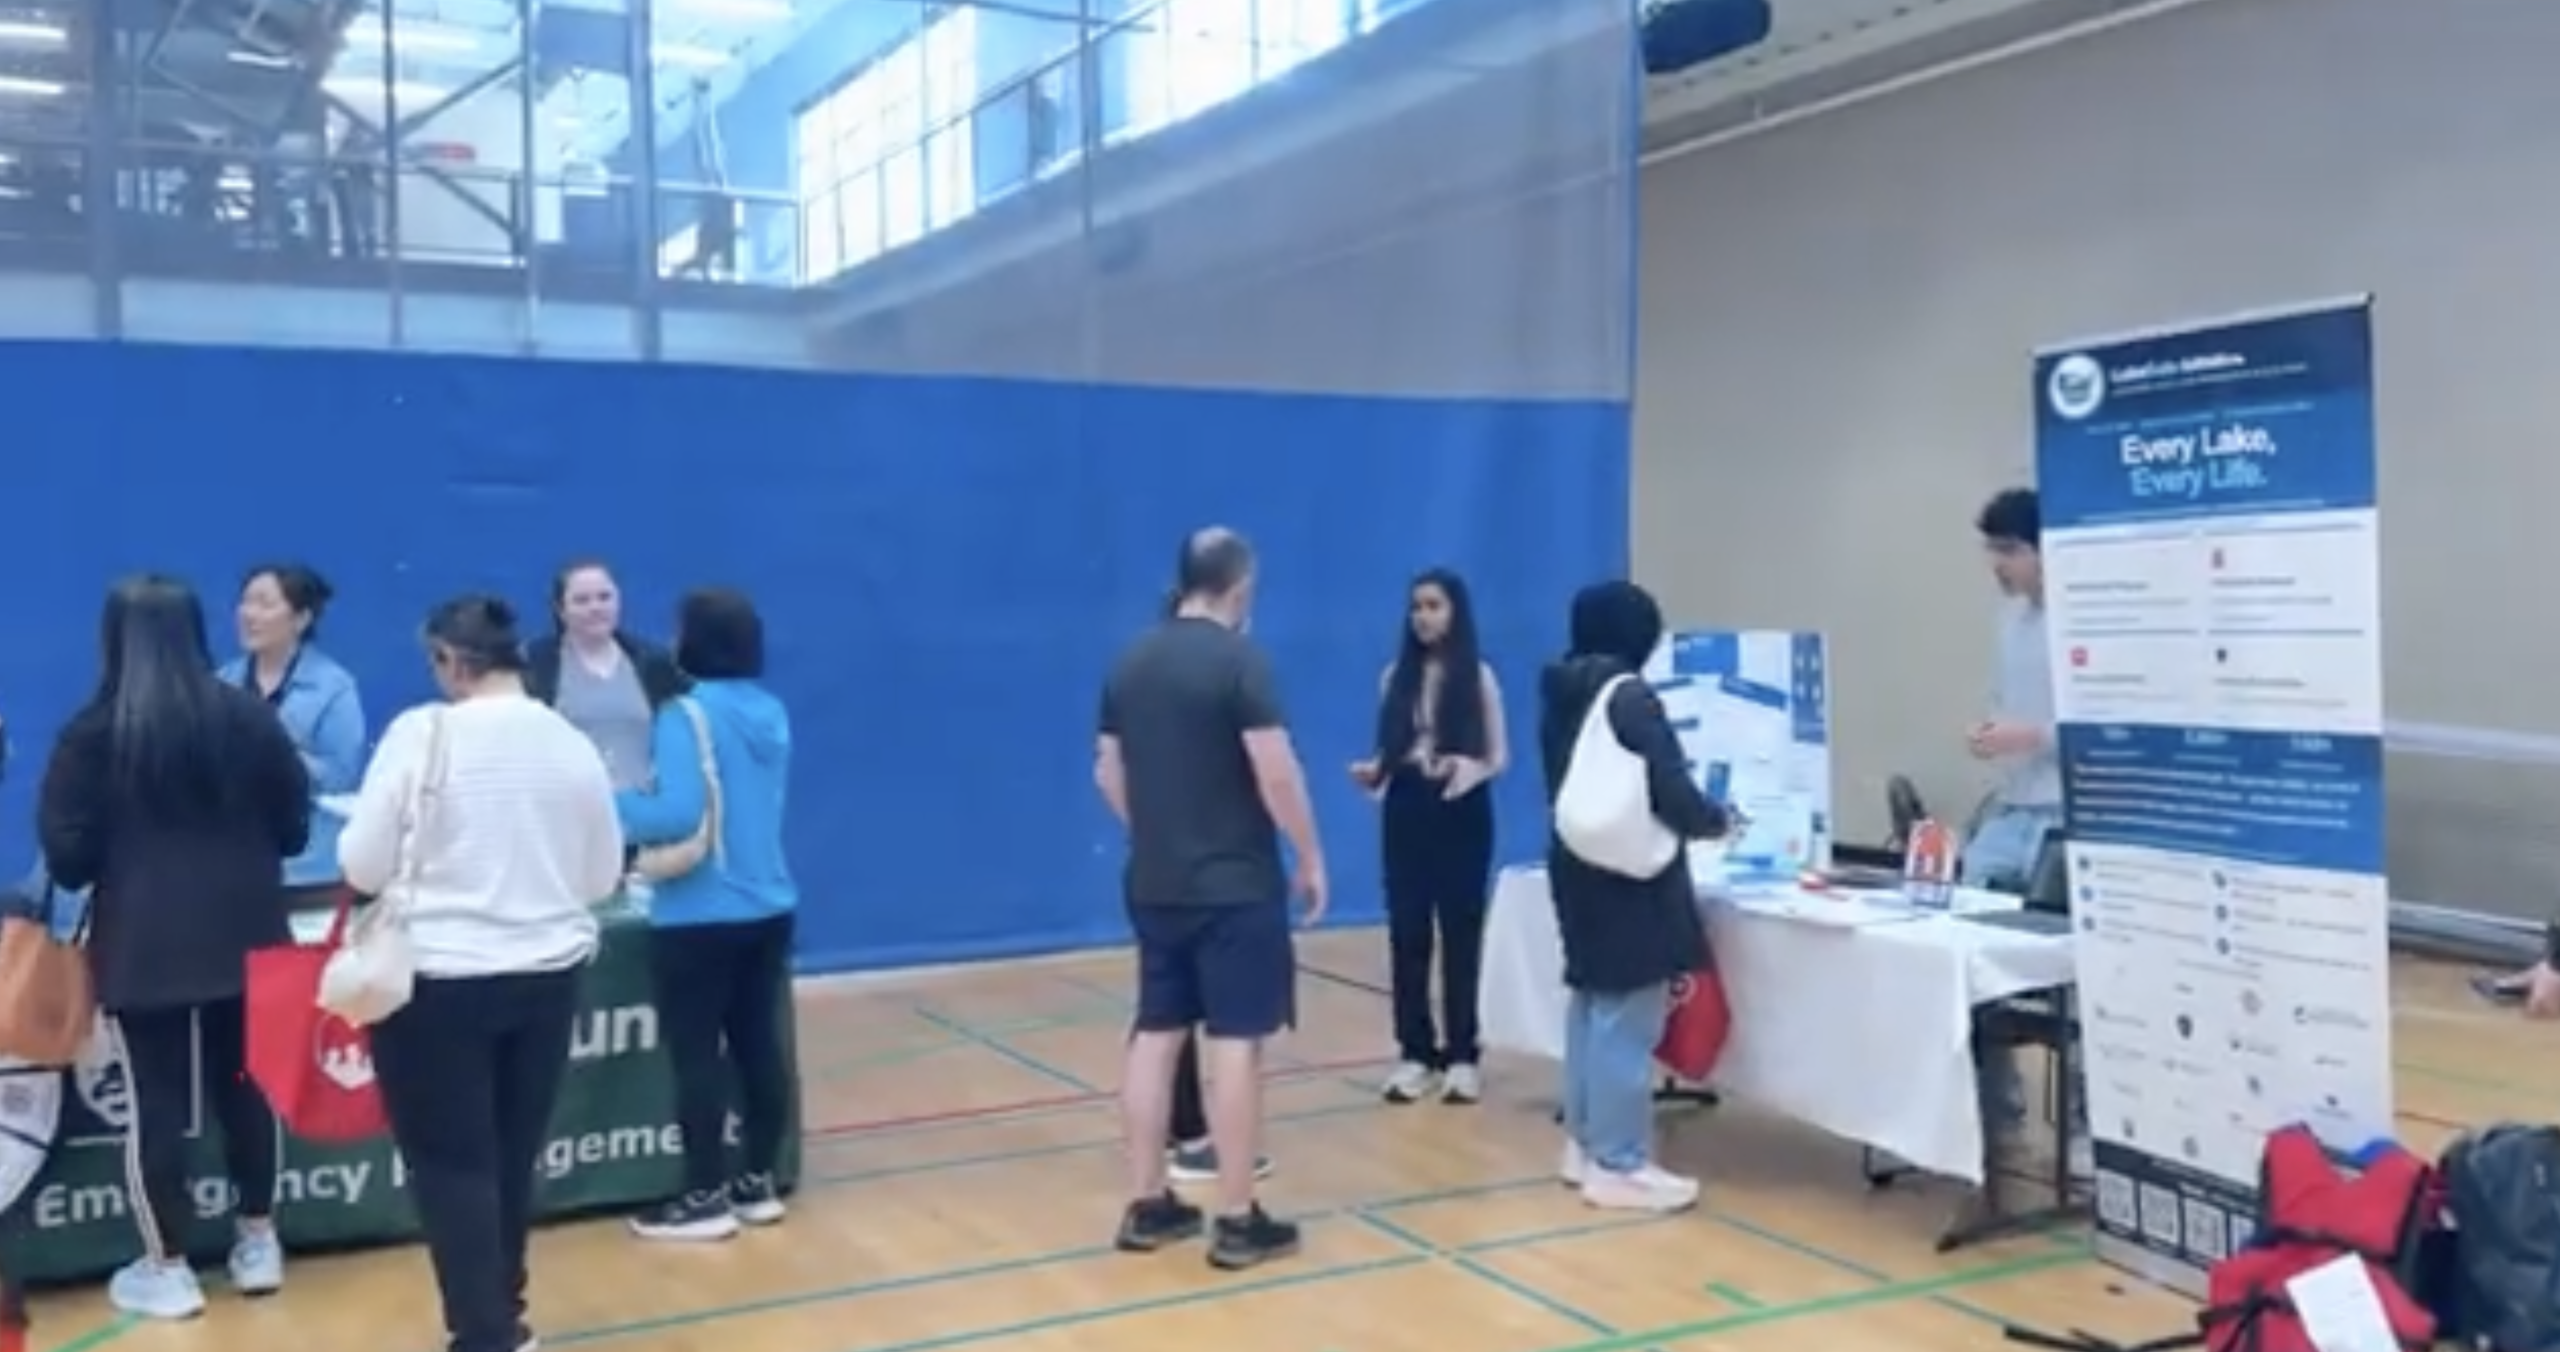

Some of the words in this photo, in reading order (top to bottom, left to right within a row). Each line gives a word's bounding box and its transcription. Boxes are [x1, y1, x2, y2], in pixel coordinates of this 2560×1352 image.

[2120, 434, 2195, 465] Every
[2200, 422, 2277, 457] Lake,
[2130, 465, 2204, 499] Every
[2208, 458, 2268, 489] Life.
[34, 1161, 371, 1229] Emgncy
